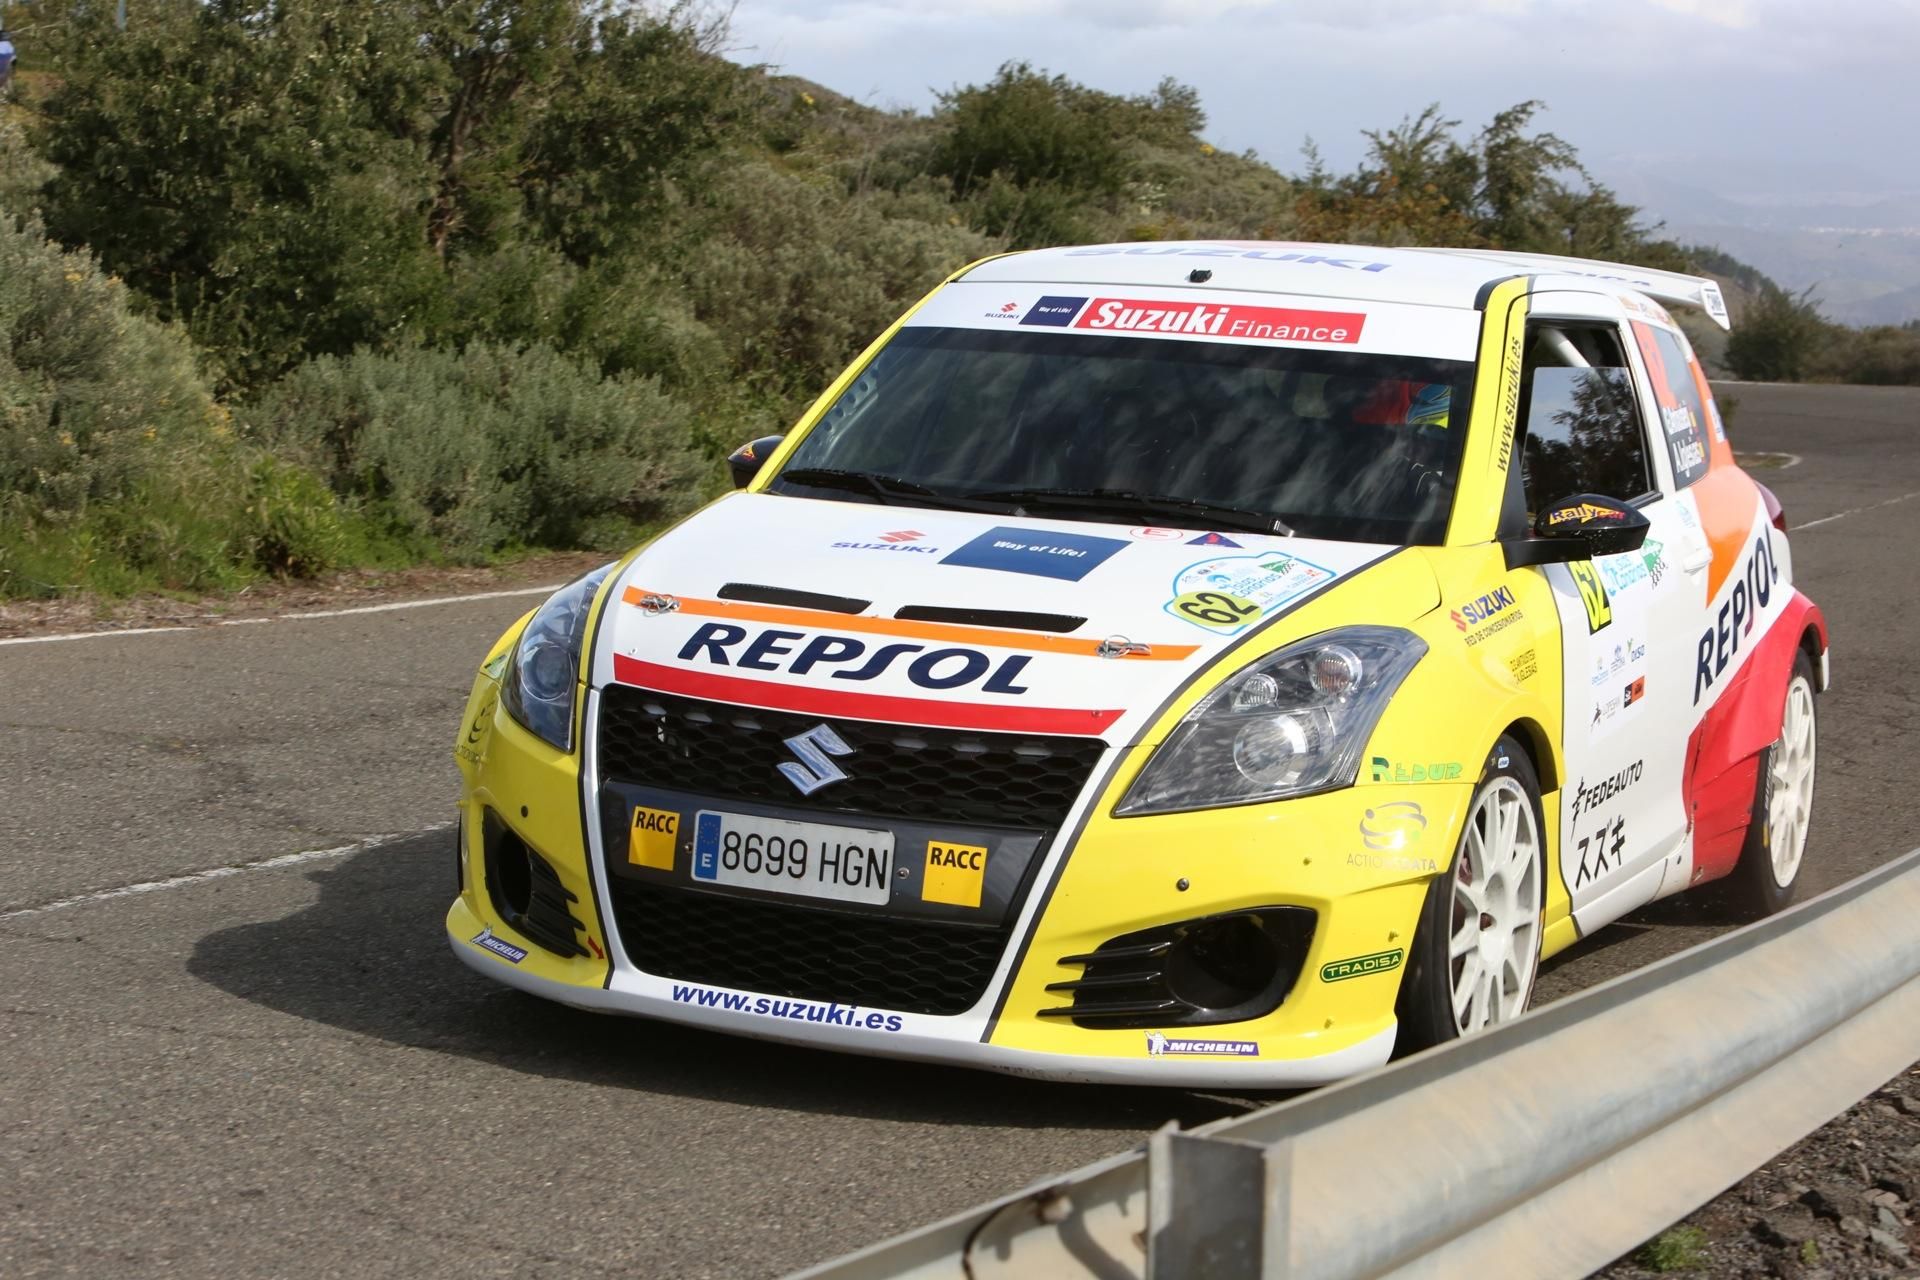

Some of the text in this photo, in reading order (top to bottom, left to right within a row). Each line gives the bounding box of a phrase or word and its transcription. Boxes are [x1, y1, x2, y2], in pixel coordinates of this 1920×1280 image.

[1063, 248, 1393, 273] SUZUKI
[1090, 301, 1348, 342] Suzuki Finance
[1497, 336, 1522, 472] www.suzuki.es
[830, 541, 939, 554] SUZUKI
[992, 540, 1026, 551] Way
[1048, 546, 1088, 558] Life!
[1179, 592, 1259, 624] 62
[1461, 585, 1516, 625] SUZUKI
[1693, 524, 1778, 707] REPSOL
[677, 622, 1033, 695] REPSOL
[1584, 759, 1643, 813] FEDEAUTO
[634, 812, 677, 835] RACC
[701, 853, 712, 868] E
[722, 830, 889, 890] 8699 HGN
[930, 848, 983, 872] RACC
[1575, 814, 1626, 890] スズキ
[482, 938, 526, 960] MICHELIN
[1326, 953, 1400, 977] TRADISA
[672, 984, 904, 1032] www.suzuki.es
[1170, 1042, 1256, 1054] MICHELIN
